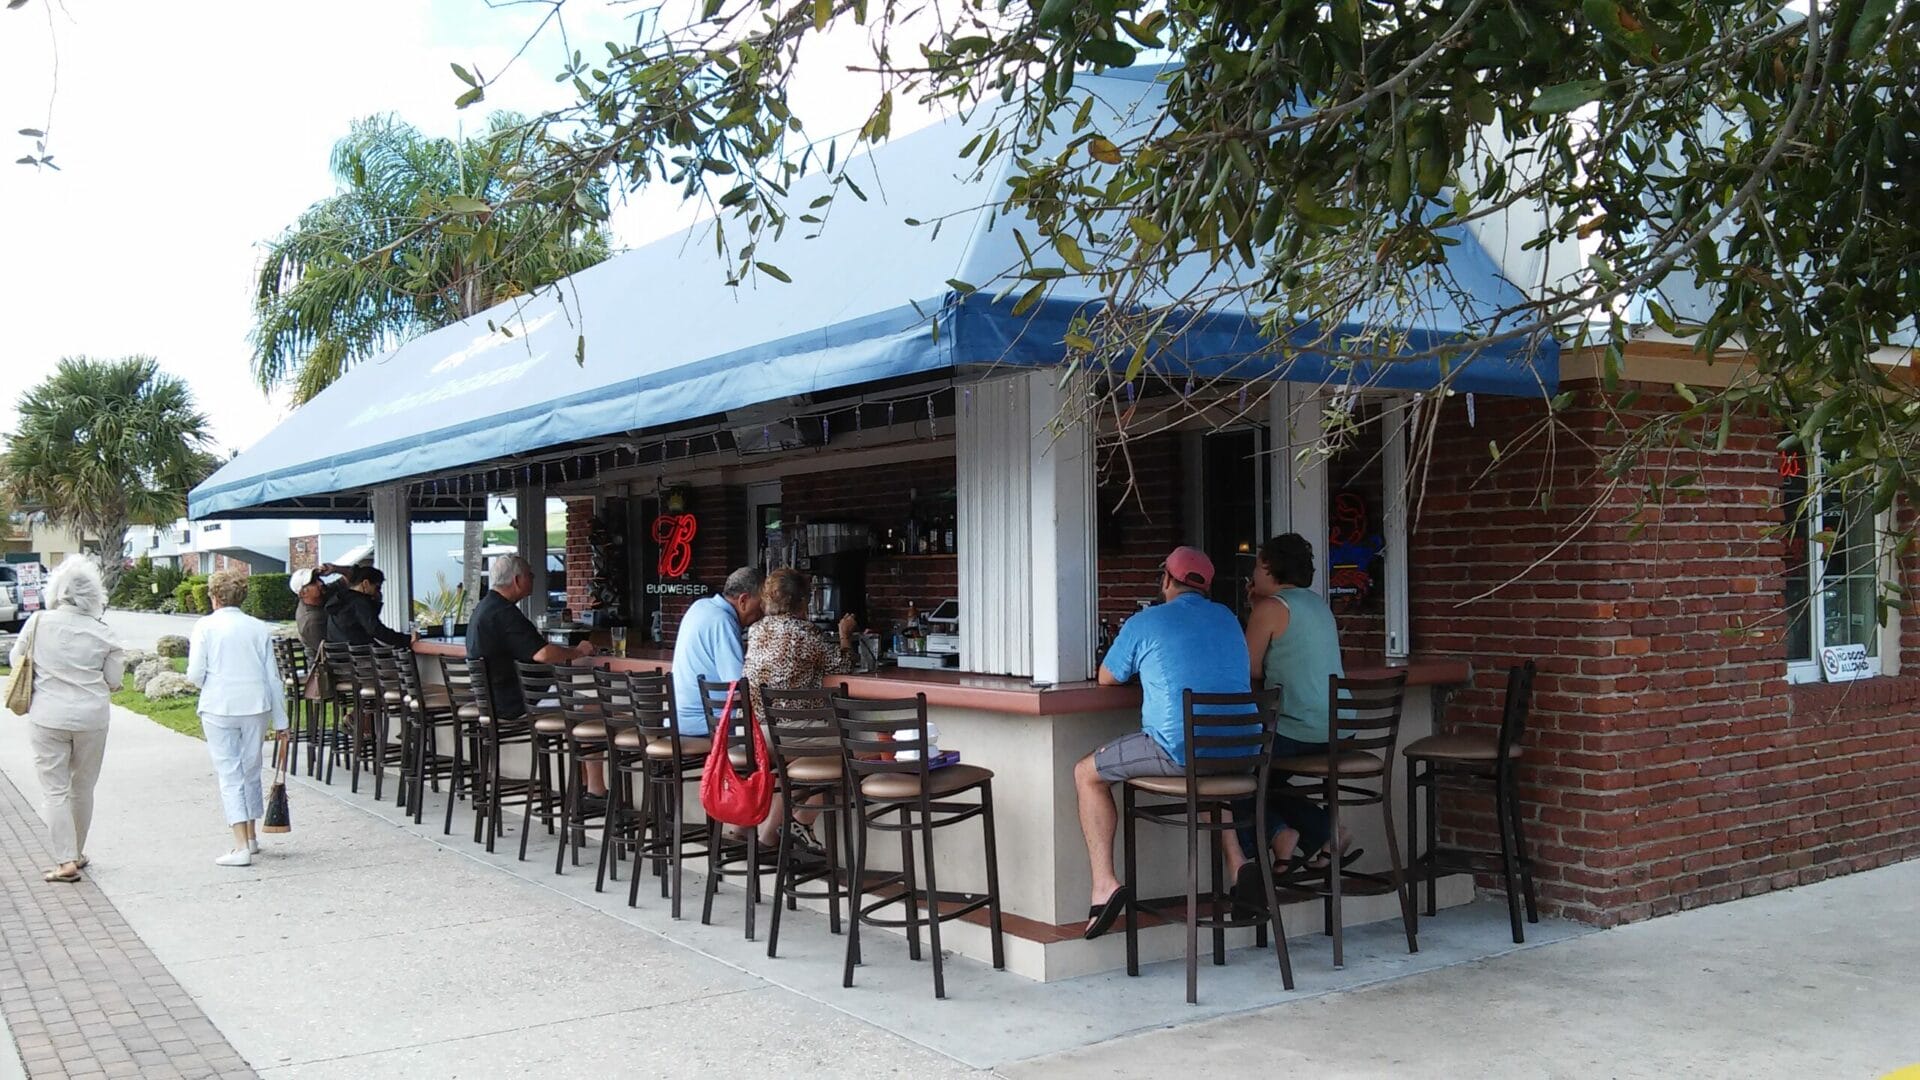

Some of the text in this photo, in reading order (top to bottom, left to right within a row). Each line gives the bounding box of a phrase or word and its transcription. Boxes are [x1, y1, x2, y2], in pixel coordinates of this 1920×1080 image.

[646, 583, 708, 595] BUDWEISER
[1837, 650, 1866, 661] NO DOGS
[1841, 661, 1870, 672] ALLOWED
